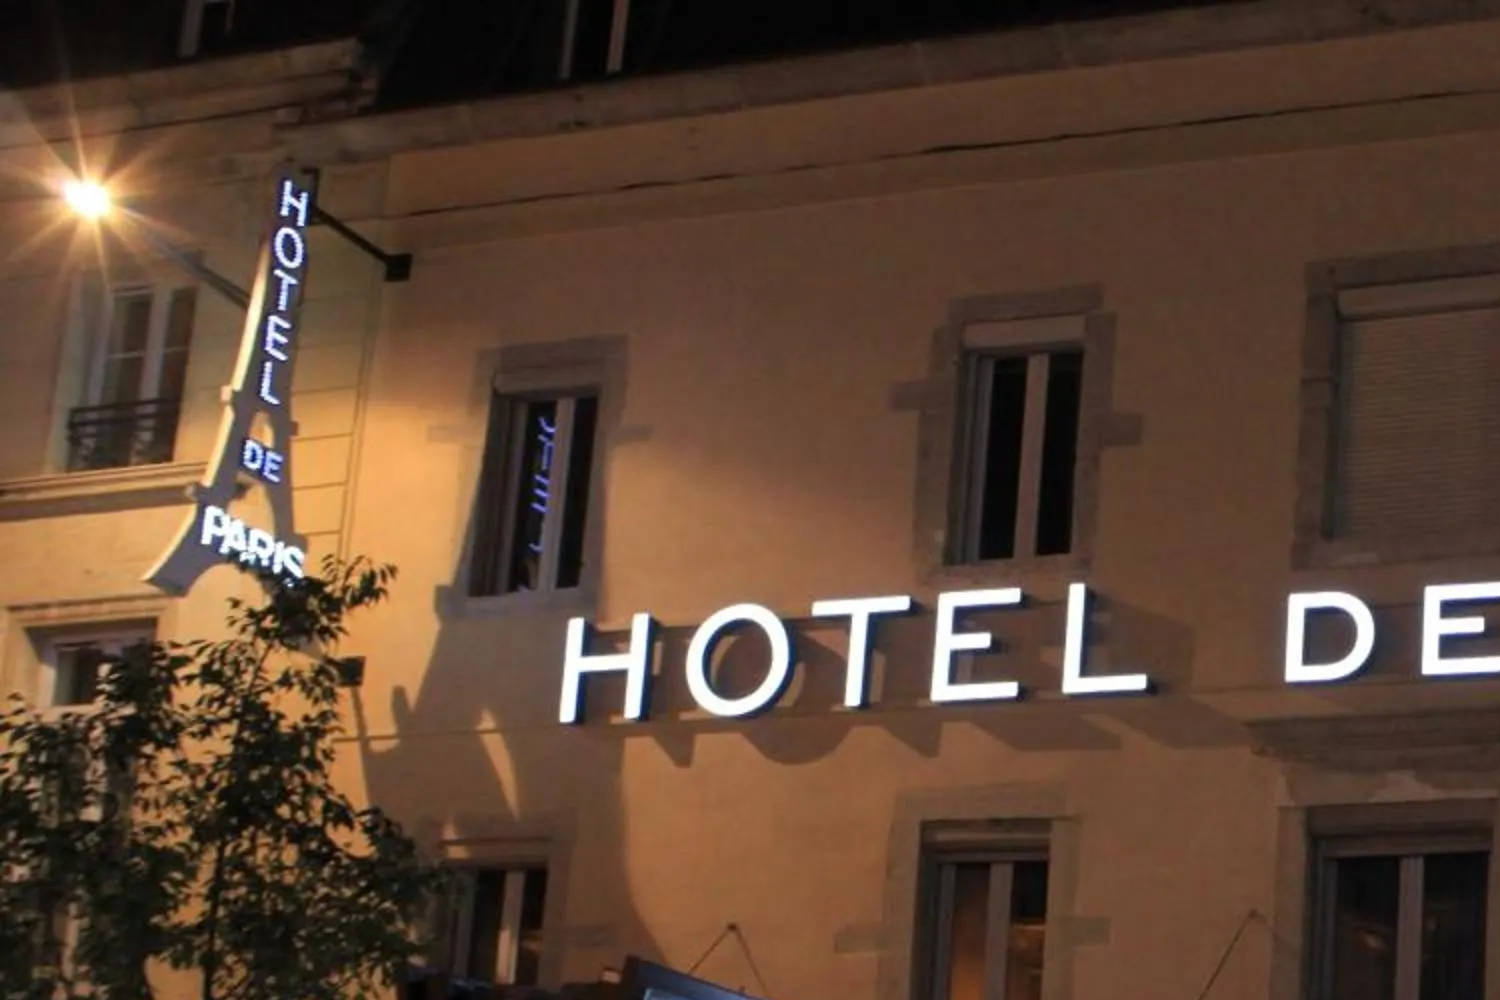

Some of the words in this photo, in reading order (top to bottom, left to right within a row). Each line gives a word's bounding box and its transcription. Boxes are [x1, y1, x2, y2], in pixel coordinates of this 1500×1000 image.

[260, 179, 309, 405] HOTEL
[242, 438, 284, 483] DE
[200, 505, 307, 580] PARIS
[558, 583, 1149, 724] HOTEL
